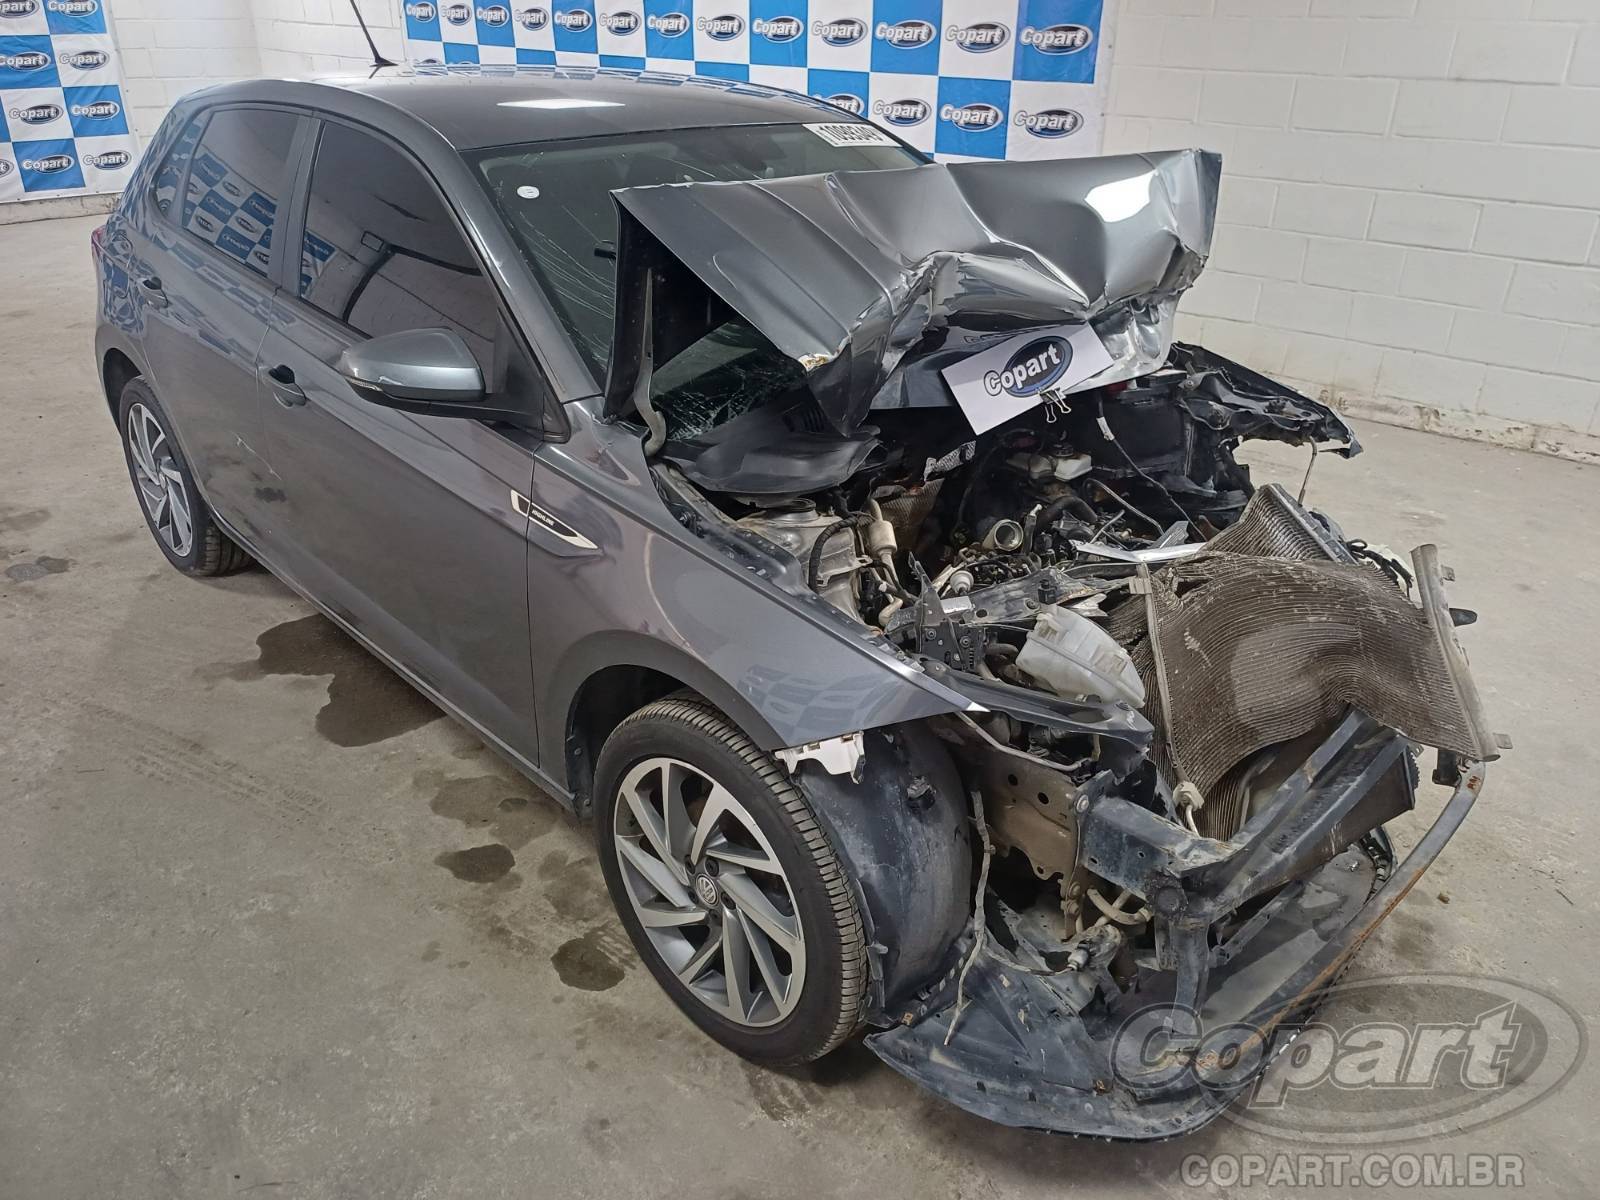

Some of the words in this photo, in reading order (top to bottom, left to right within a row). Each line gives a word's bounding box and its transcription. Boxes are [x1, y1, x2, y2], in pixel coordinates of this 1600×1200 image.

[0, 1, 33, 13] part
[49, 1, 93, 13] Copart
[514, 9, 545, 23] Copart
[554, 11, 587, 26] Copart
[600, 13, 635, 29] Copart
[647, 14, 684, 33] Copart
[697, 17, 739, 35] Copart
[753, 18, 798, 37] Copart
[812, 21, 859, 39] Copart
[875, 22, 929, 43] Copart
[946, 25, 1001, 45] Copart
[1021, 27, 1084, 49] Copart
[60, 53, 104, 65] Copart
[10, 107, 56, 121] Copart
[72, 103, 115, 117] Copart
[873, 100, 923, 119] Copart
[940, 104, 996, 126] Copart
[1015, 110, 1074, 131] Copart
[23, 157, 69, 171] Copart
[84, 153, 127, 167] Copart
[984, 344, 1060, 396] Copart
